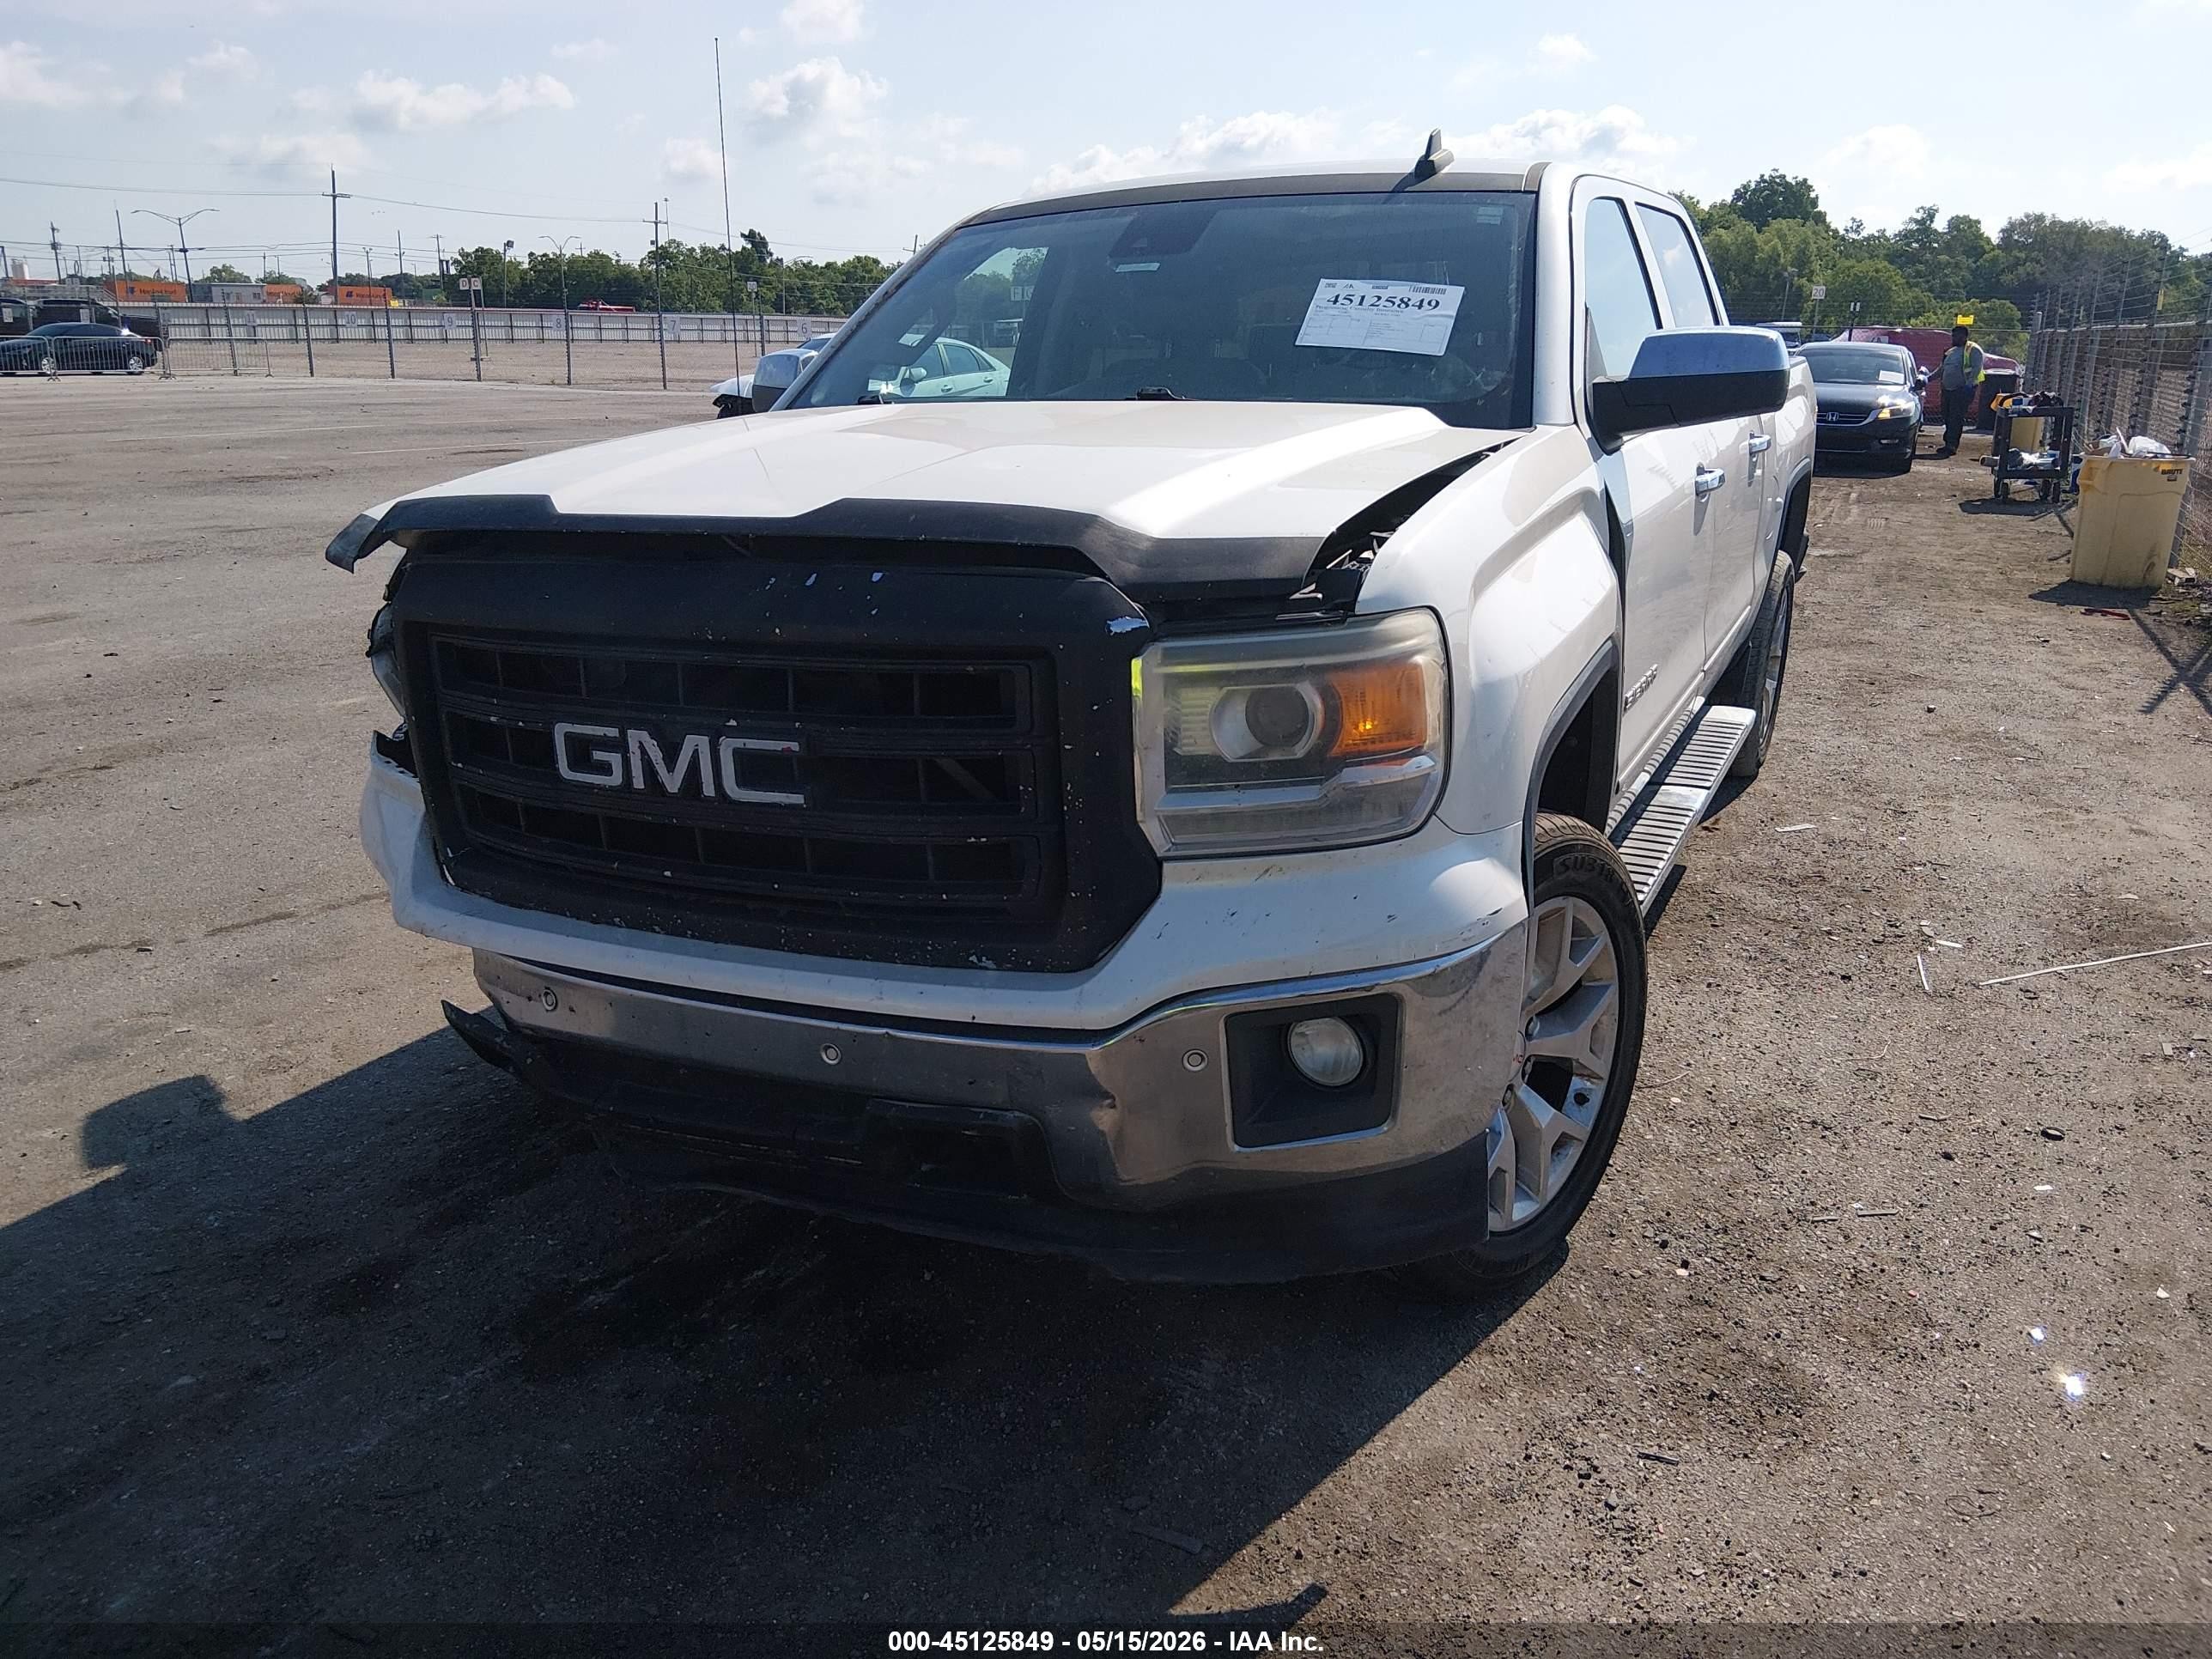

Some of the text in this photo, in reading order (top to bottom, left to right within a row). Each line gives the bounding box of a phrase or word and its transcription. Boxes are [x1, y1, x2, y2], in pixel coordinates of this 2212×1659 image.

[461, 279, 479, 288] D C
[1813, 288, 1825, 297] 20
[1326, 293, 1441, 312] 45125849
[345, 314, 356, 325] 10
[447, 315, 453, 327] 9
[556, 318, 562, 329] 8
[670, 319, 678, 331] 7
[801, 322, 809, 334] 6
[554, 722, 805, 805] GMC
